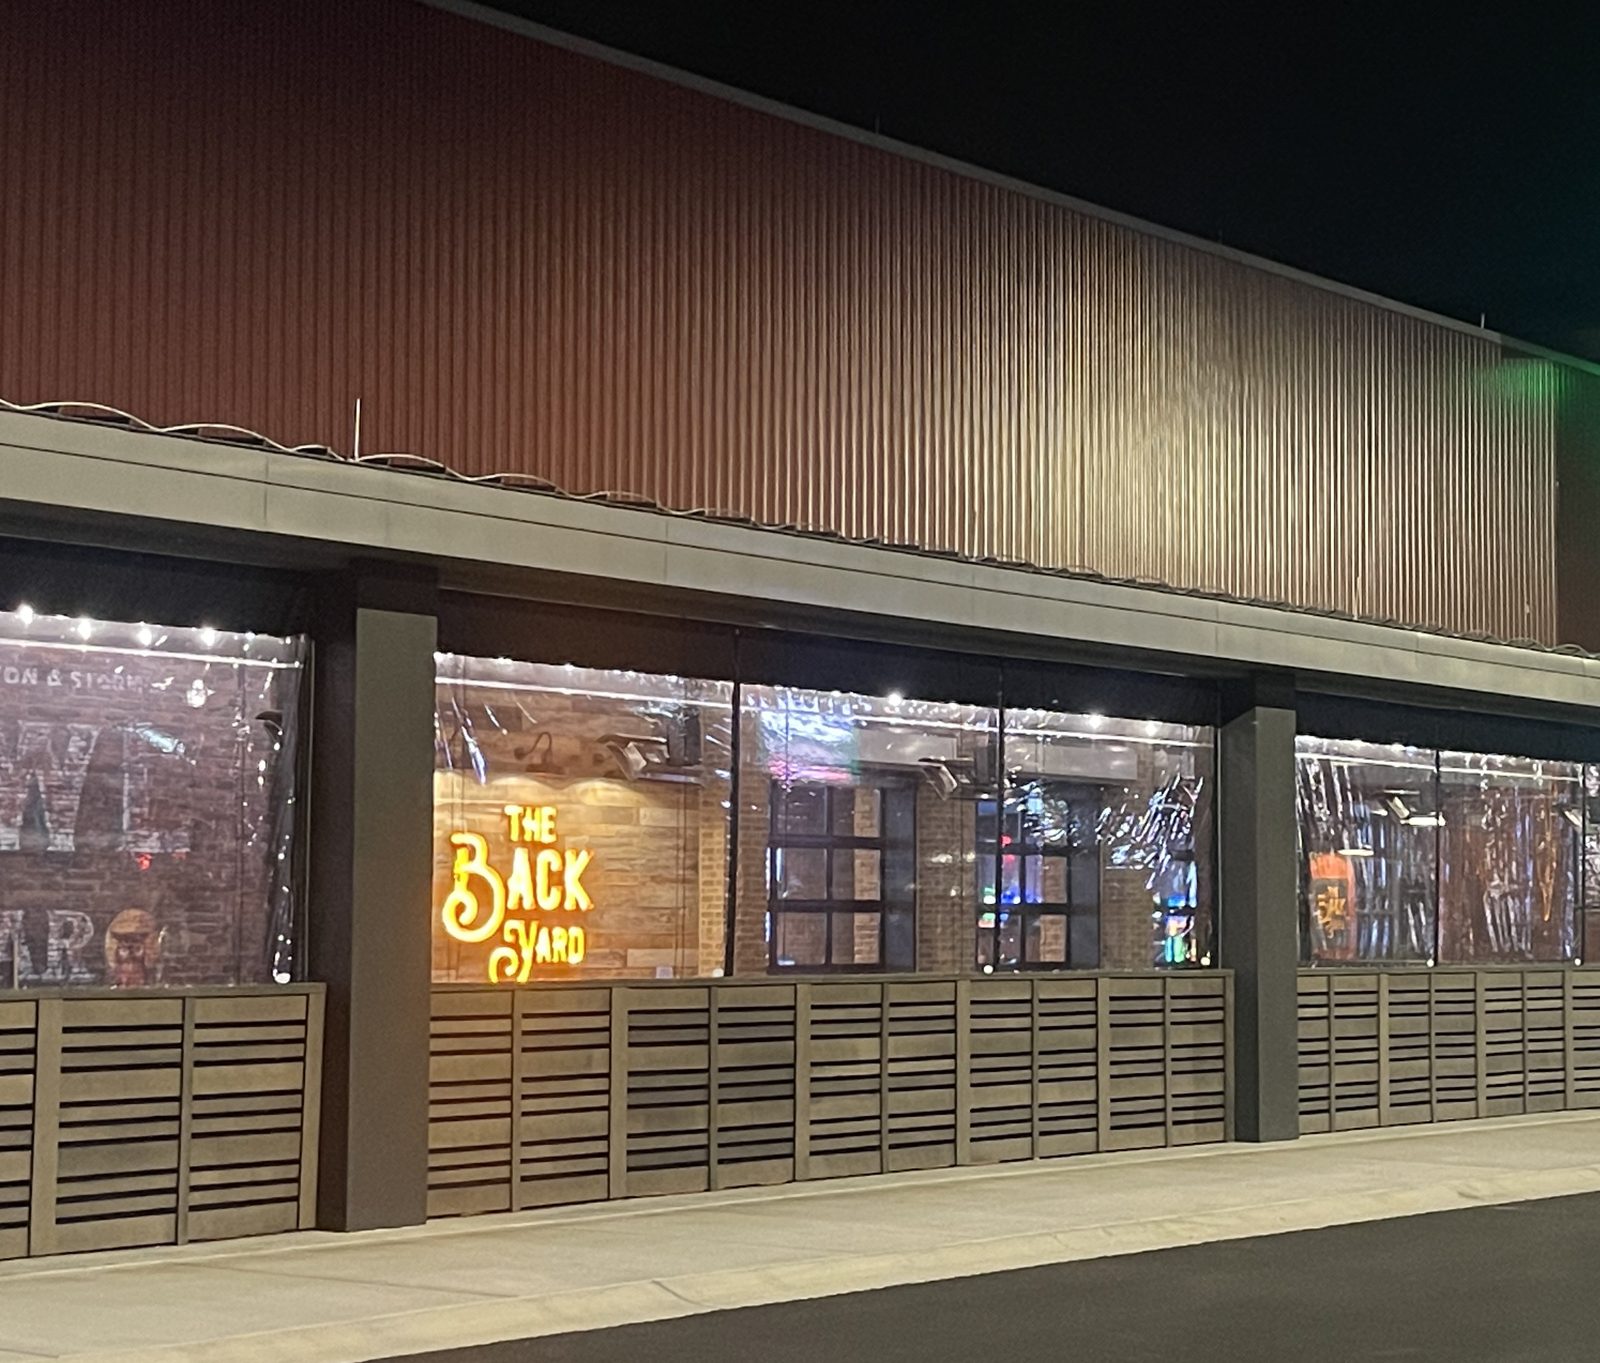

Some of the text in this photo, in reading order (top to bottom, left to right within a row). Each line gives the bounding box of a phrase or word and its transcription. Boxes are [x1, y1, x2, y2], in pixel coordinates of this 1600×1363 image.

[0, 666, 37, 685] ON
[47, 669, 62, 686] &
[504, 805, 557, 843] THE
[442, 833, 594, 942] BACK
[489, 919, 585, 983] YARD
